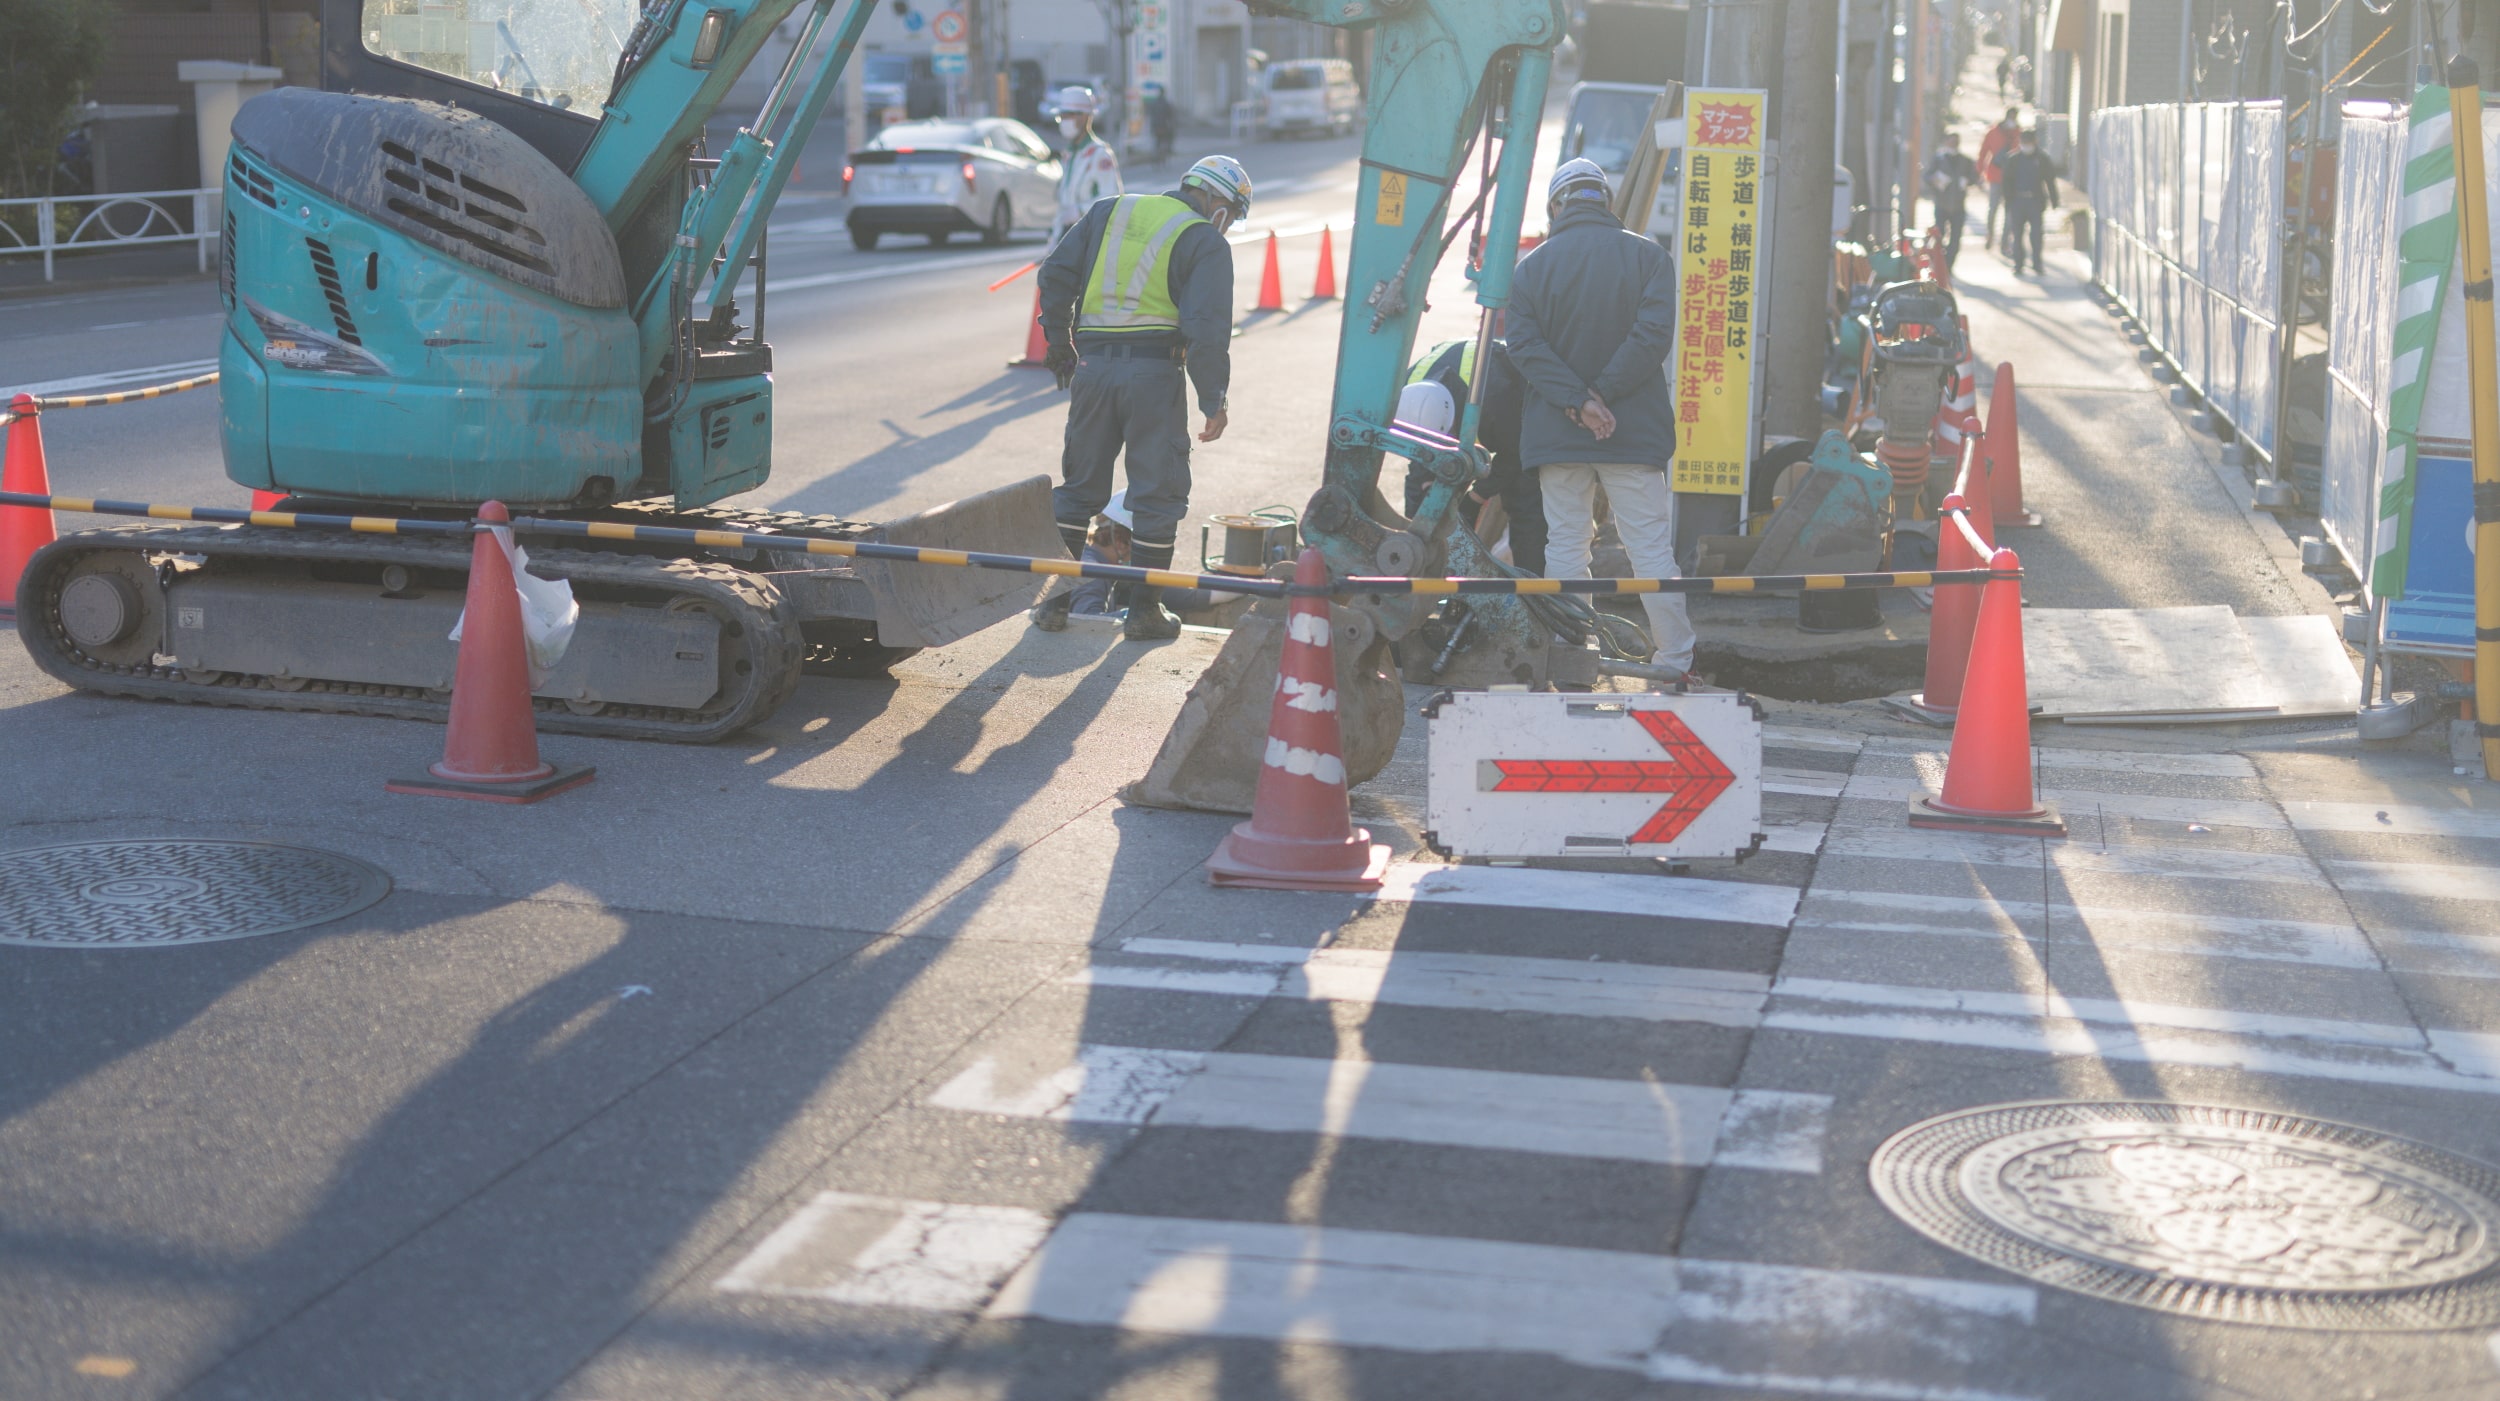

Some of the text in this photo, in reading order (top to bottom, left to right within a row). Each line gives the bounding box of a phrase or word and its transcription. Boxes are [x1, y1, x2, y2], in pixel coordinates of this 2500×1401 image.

[1703, 110, 1743, 122] マナー
[1708, 123, 1750, 139] アップ
[1727, 156, 1755, 361] 歩道・横断歩道は、
[1702, 258, 1729, 396] 歩行者優先。
